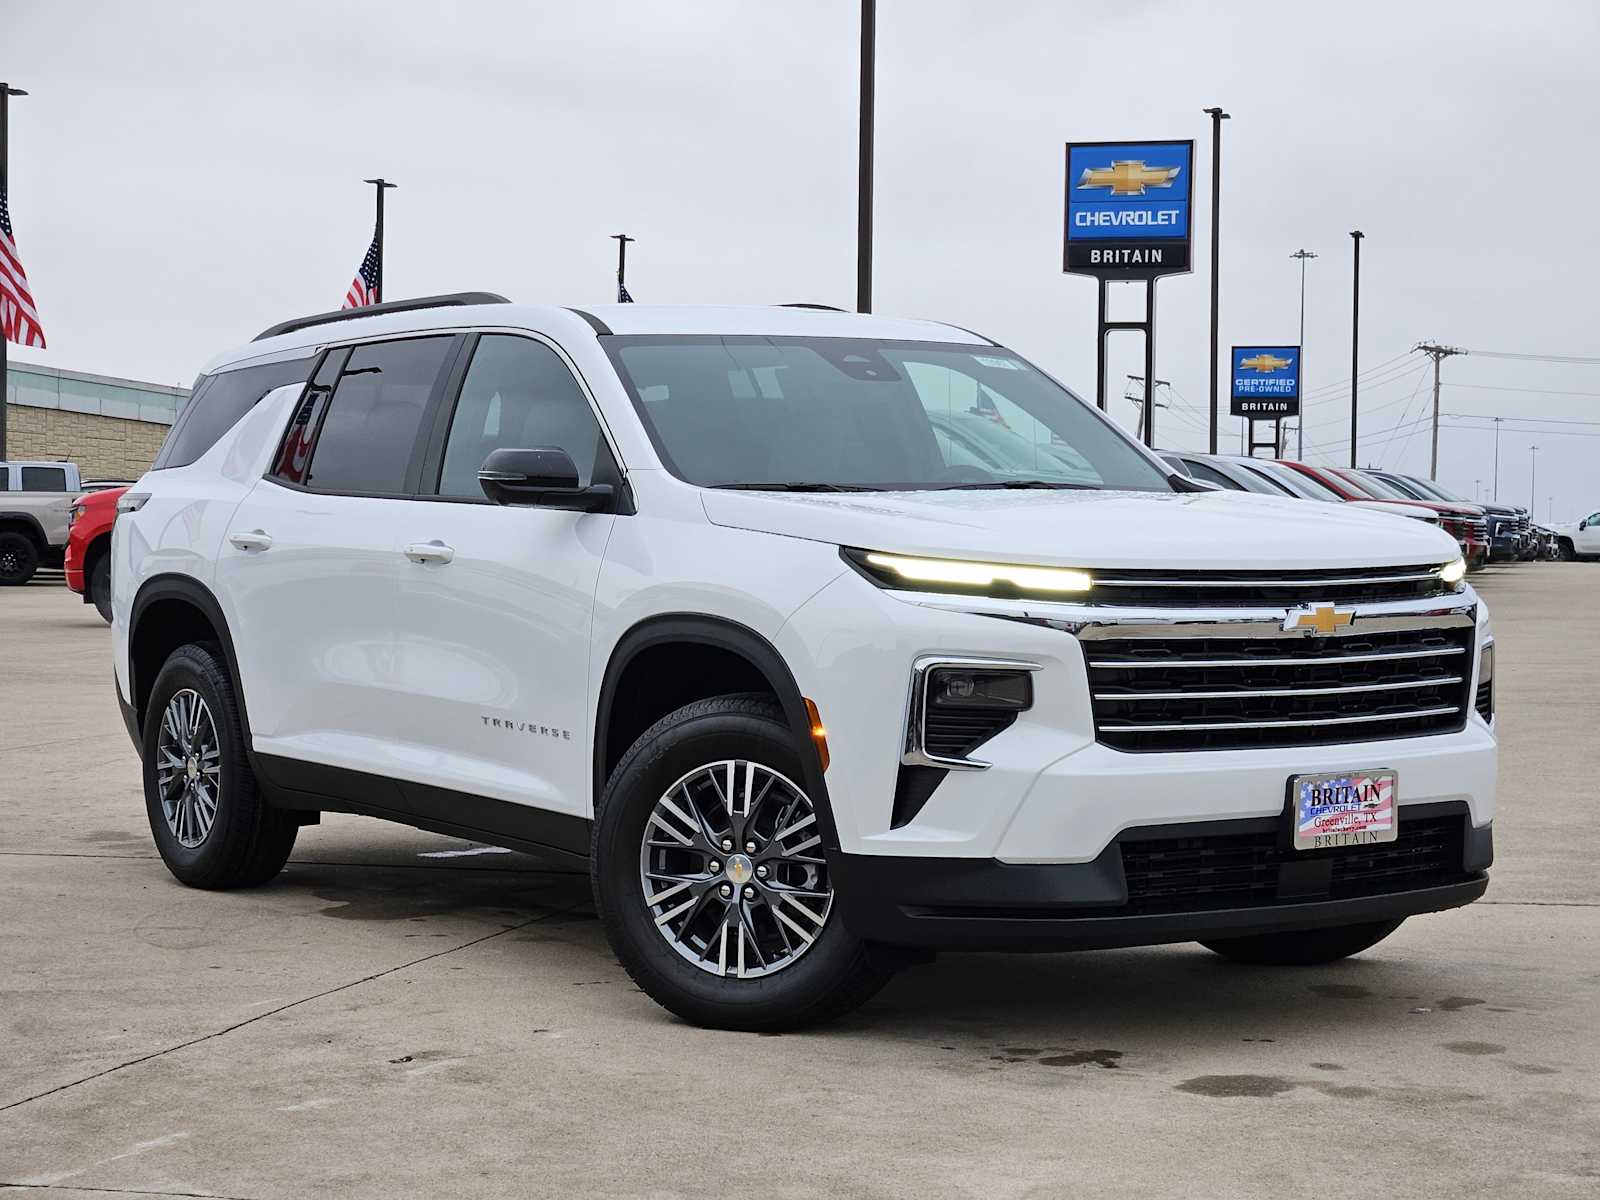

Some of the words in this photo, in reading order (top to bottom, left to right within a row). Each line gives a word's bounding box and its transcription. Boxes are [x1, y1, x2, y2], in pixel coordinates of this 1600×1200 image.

[1075, 210, 1179, 226] CHEVROLET
[1091, 249, 1162, 263] BRITAIN
[1235, 378, 1295, 386] CERTIFIED
[1239, 385, 1292, 393] PRE-OWNED
[1241, 402, 1288, 411] BRITAIN
[481, 716, 570, 740] TRAVERSE
[1311, 783, 1381, 806] BRITAIN
[1310, 804, 1361, 815] CHEVROLET
[1314, 813, 1361, 828] Greenville,
[1364, 812, 1377, 823] TX
[1314, 831, 1378, 847] BRITAIN
